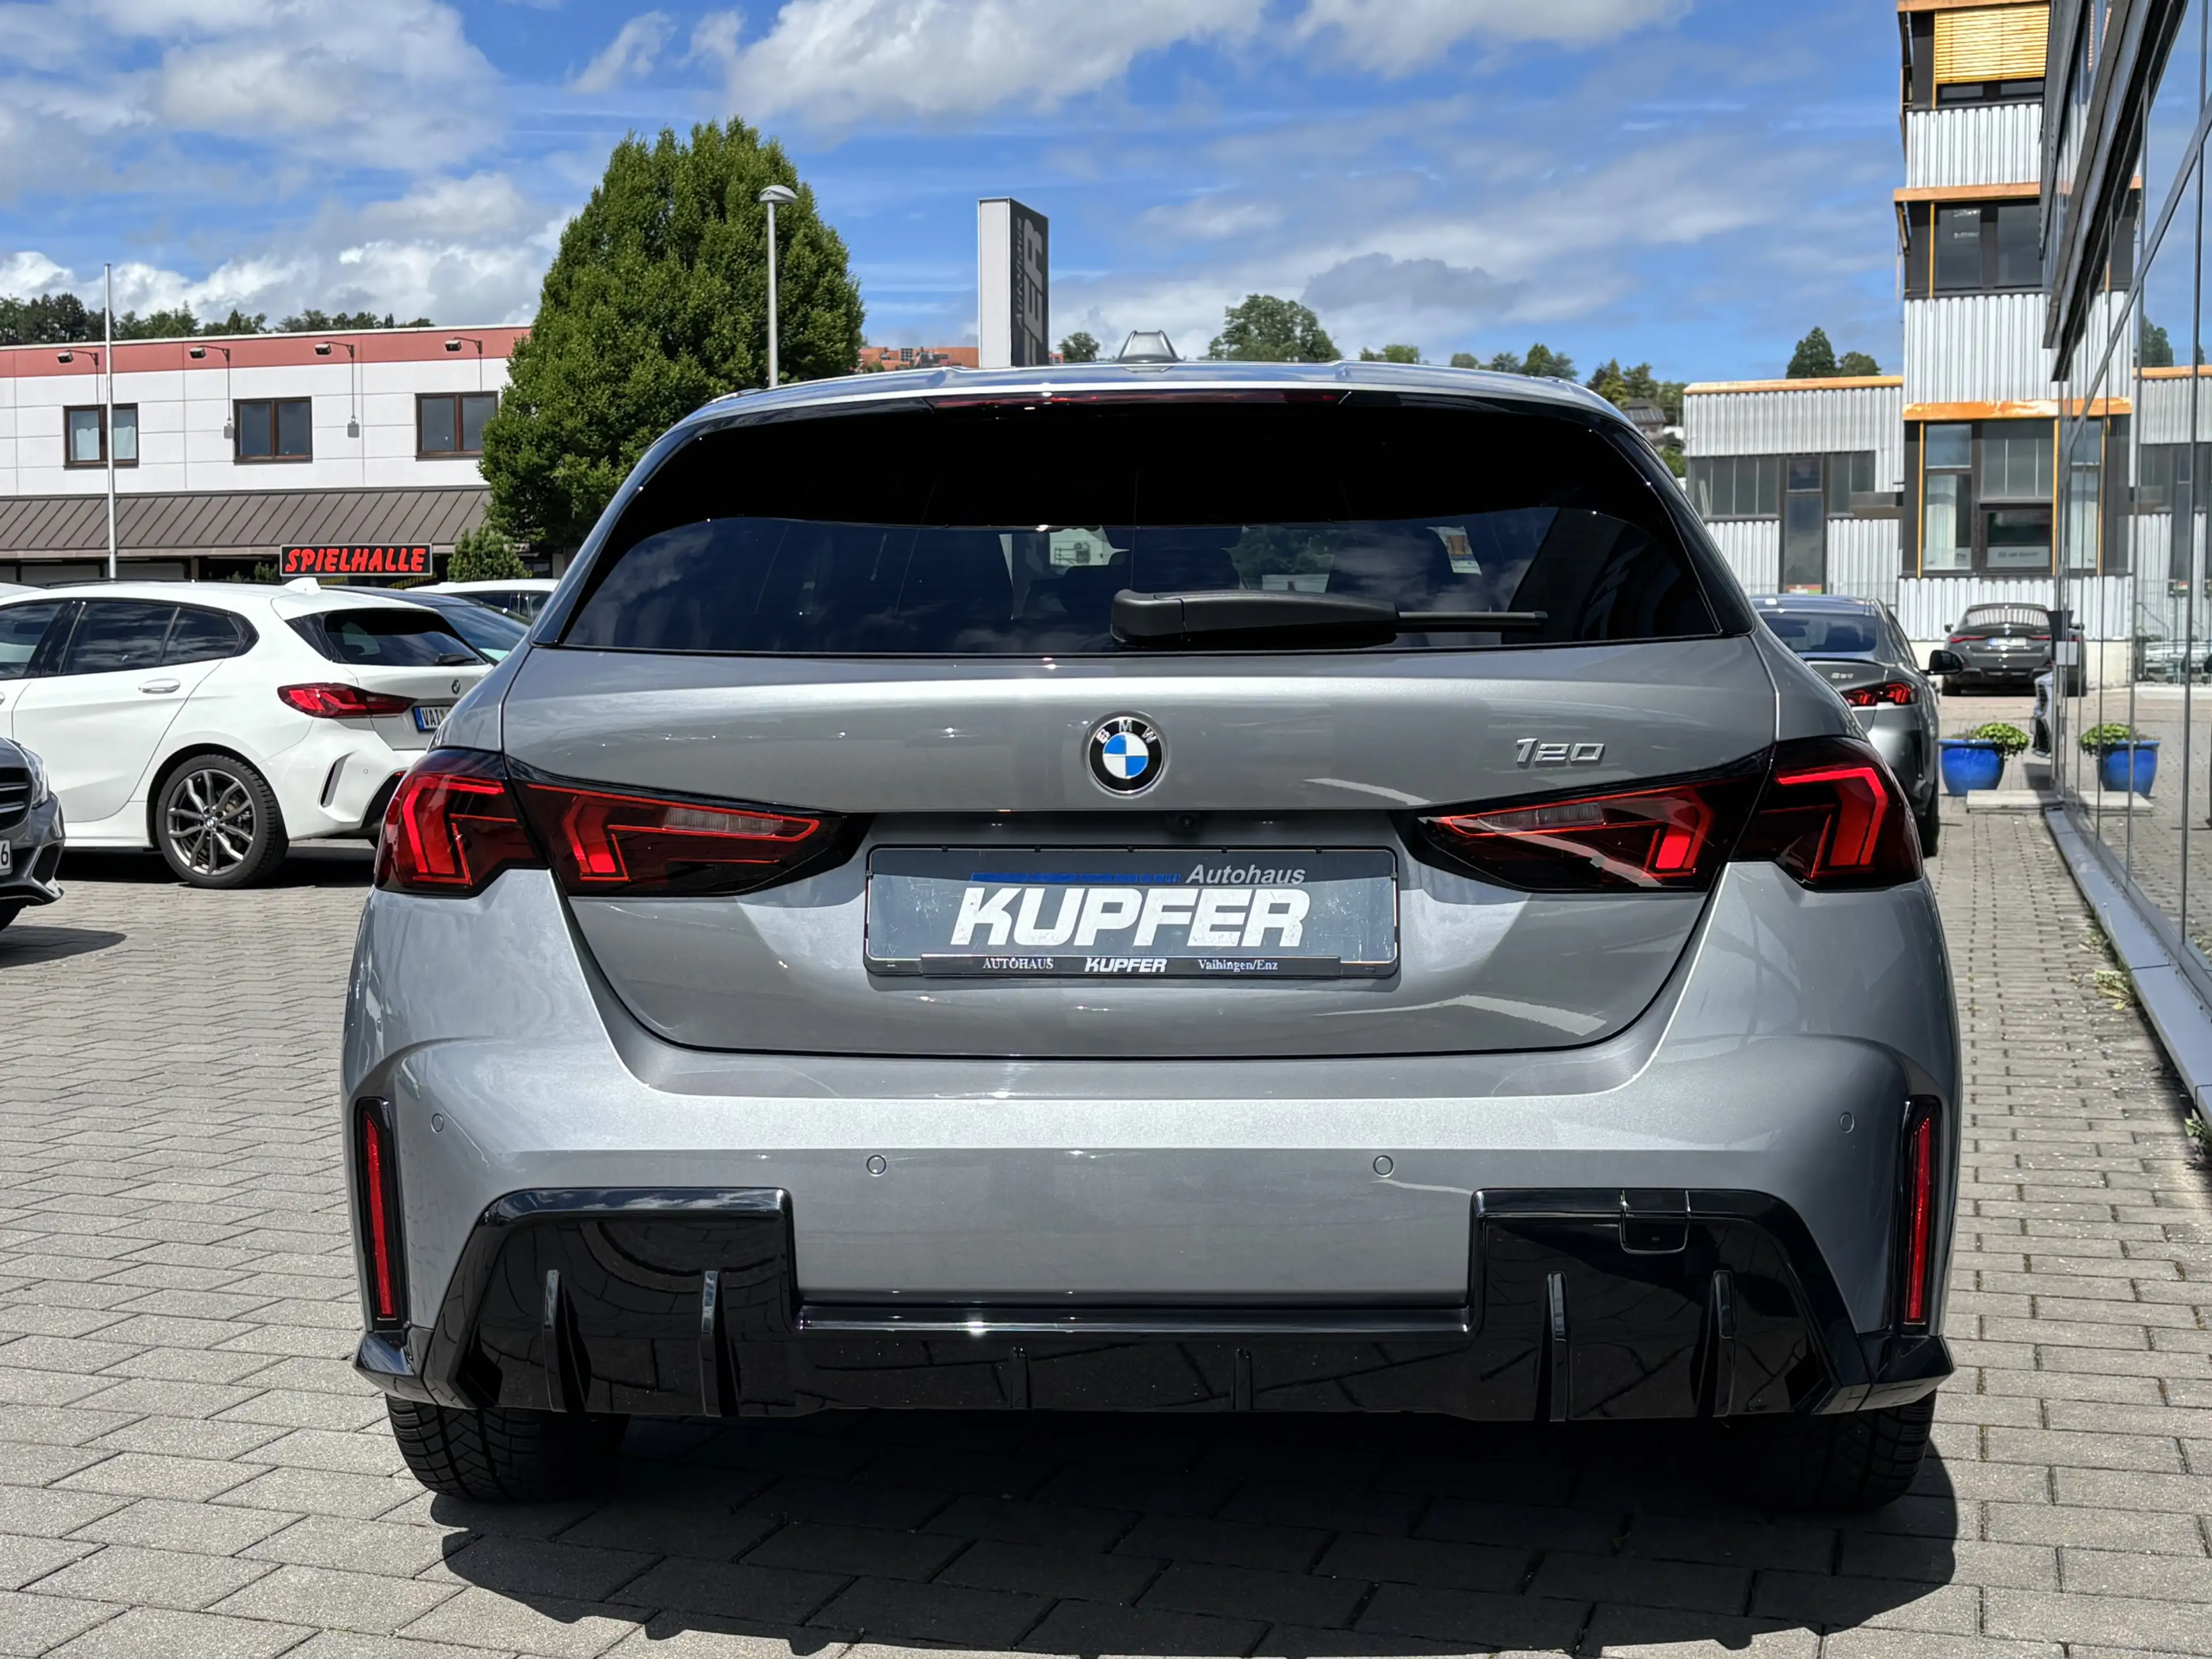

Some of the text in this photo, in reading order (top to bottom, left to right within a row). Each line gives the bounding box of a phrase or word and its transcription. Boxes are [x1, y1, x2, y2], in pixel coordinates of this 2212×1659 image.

[286, 548, 426, 571] SPIELHALLE
[1096, 719, 1157, 744] BMW
[1517, 738, 1605, 766] 120
[1186, 865, 1306, 884] Autohaus
[951, 888, 1310, 946] KUPFER
[983, 957, 1278, 972] AUTOHAUS KUPFER Vaihingen/Enz
